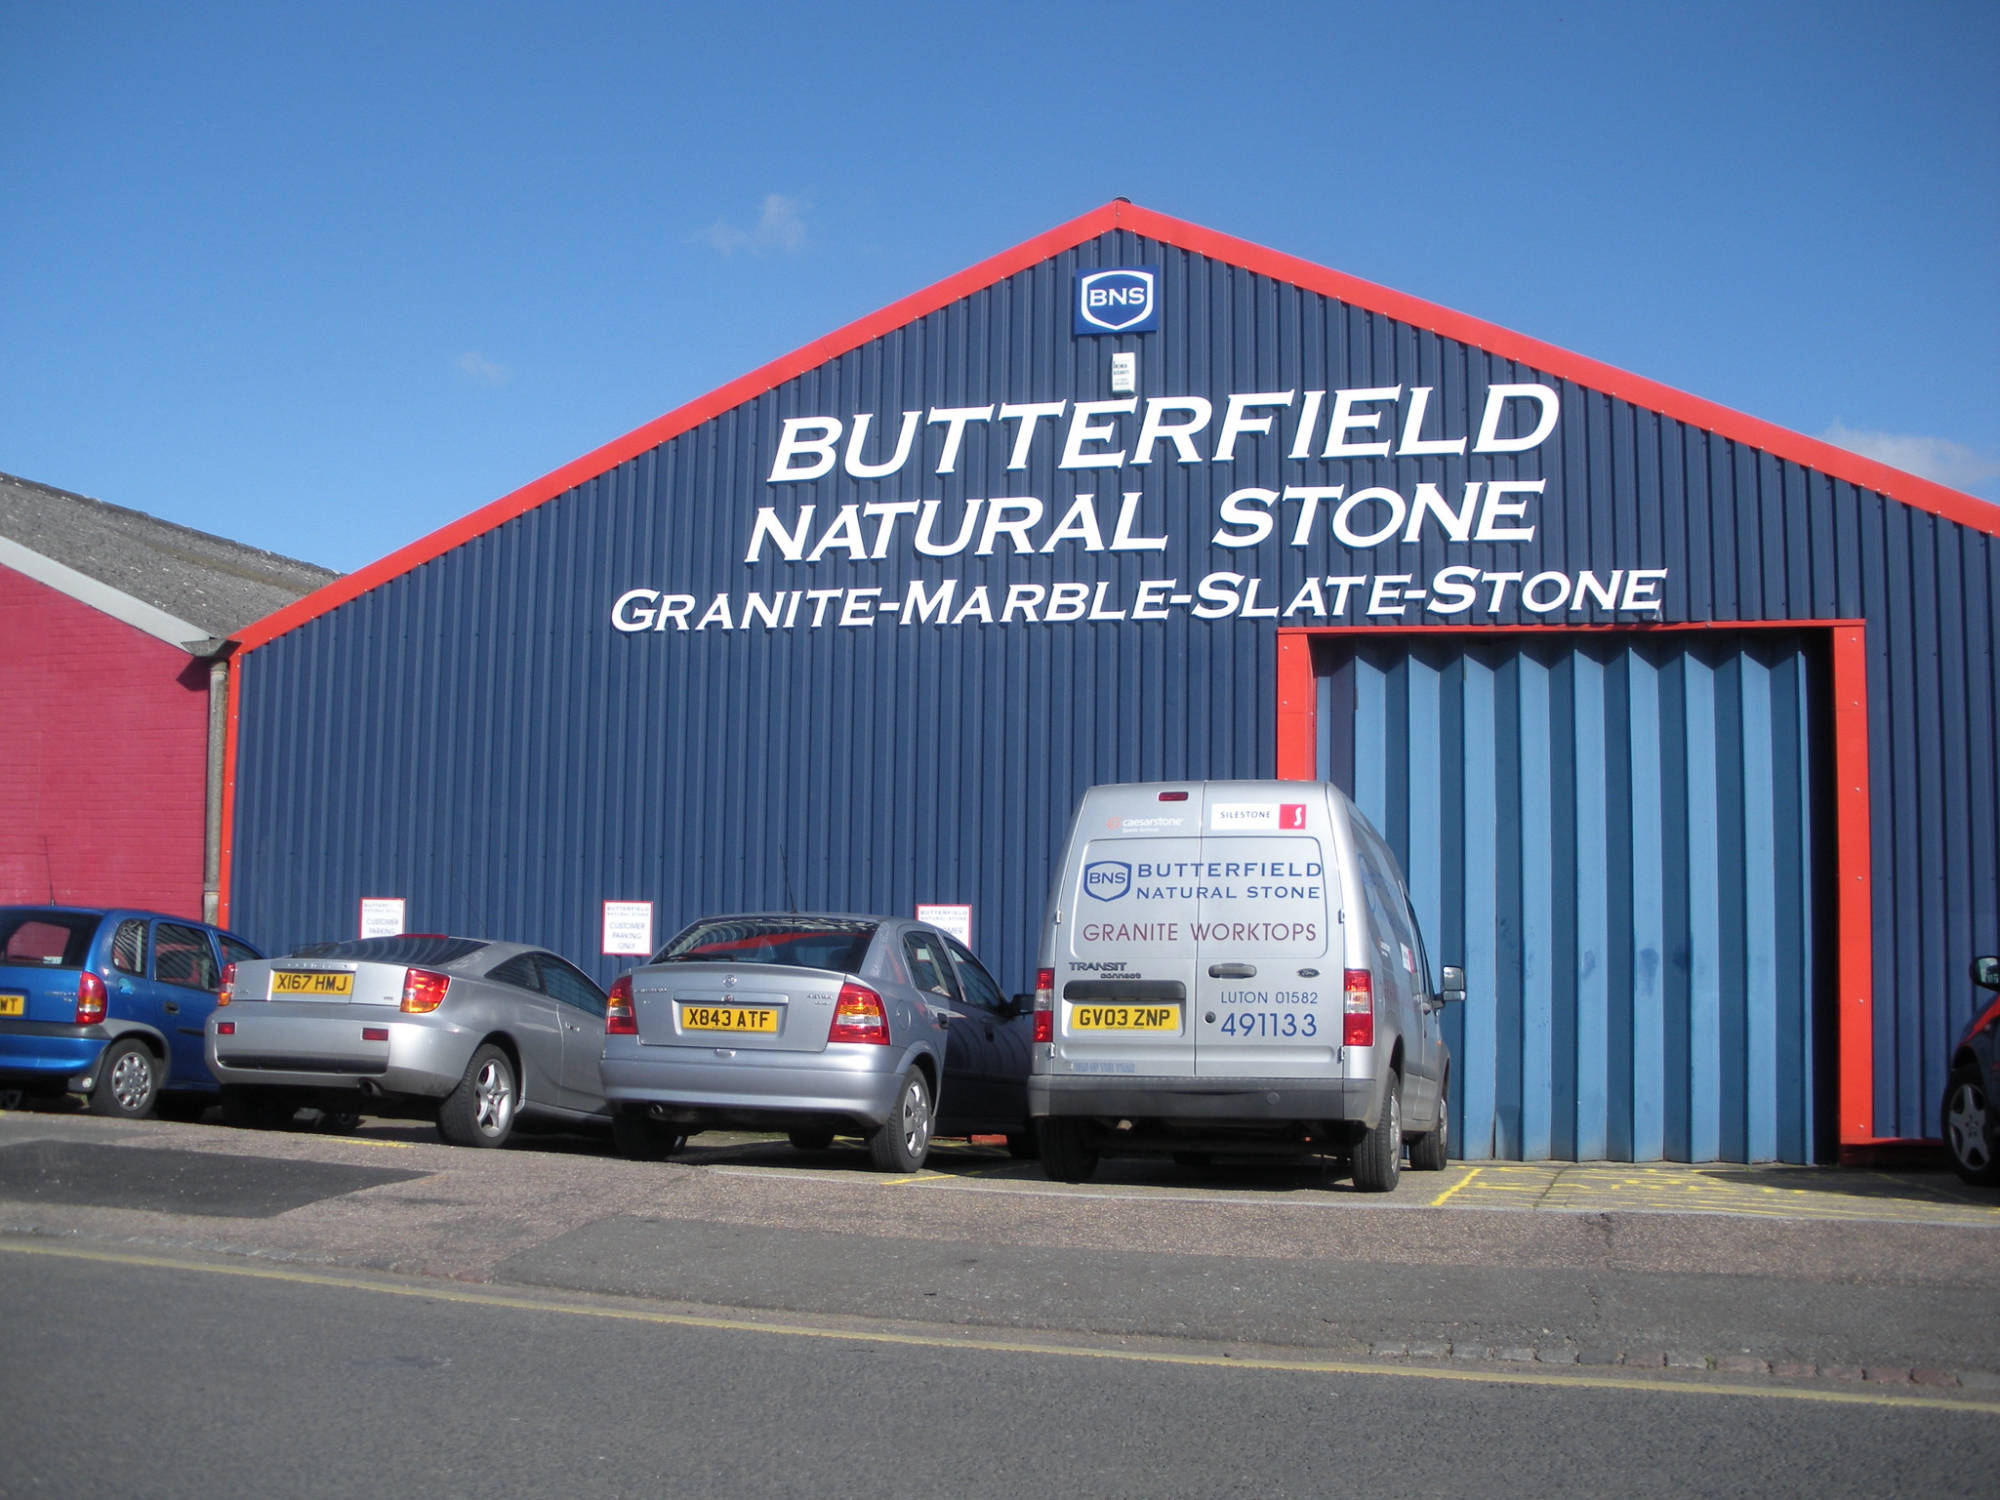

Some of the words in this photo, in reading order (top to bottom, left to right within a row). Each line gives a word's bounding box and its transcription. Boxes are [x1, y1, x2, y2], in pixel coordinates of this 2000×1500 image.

[1089, 287, 1145, 307] BNS
[767, 383, 1560, 482] BUTTERFIELD
[744, 491, 1168, 563] NATURAL
[1211, 478, 1546, 548] STONE
[1219, 810, 1271, 819] SILESTONE
[1089, 871, 1126, 885] BNS
[1137, 862, 1322, 878] BUTTERFIELD
[1136, 886, 1237, 900] NATURAL
[1247, 885, 1321, 899] STONE
[609, 921, 646, 930] CUSTOMER
[1083, 922, 1179, 942] GRANITE
[1190, 922, 1317, 942] WORKTOPS
[612, 931, 642, 940] PARKING
[1069, 962, 1128, 972] TRANSIT
[276, 974, 312, 991] X167
[314, 975, 348, 992] HMJ
[1221, 991, 1268, 1004] LUTON
[1275, 991, 1318, 1005] 01582
[688, 1008, 732, 1026] X843
[737, 1010, 770, 1028] ATF
[1080, 1009, 1128, 1026] GV03
[1133, 1009, 1170, 1026] ZNP
[1220, 1012, 1317, 1037] 491133
